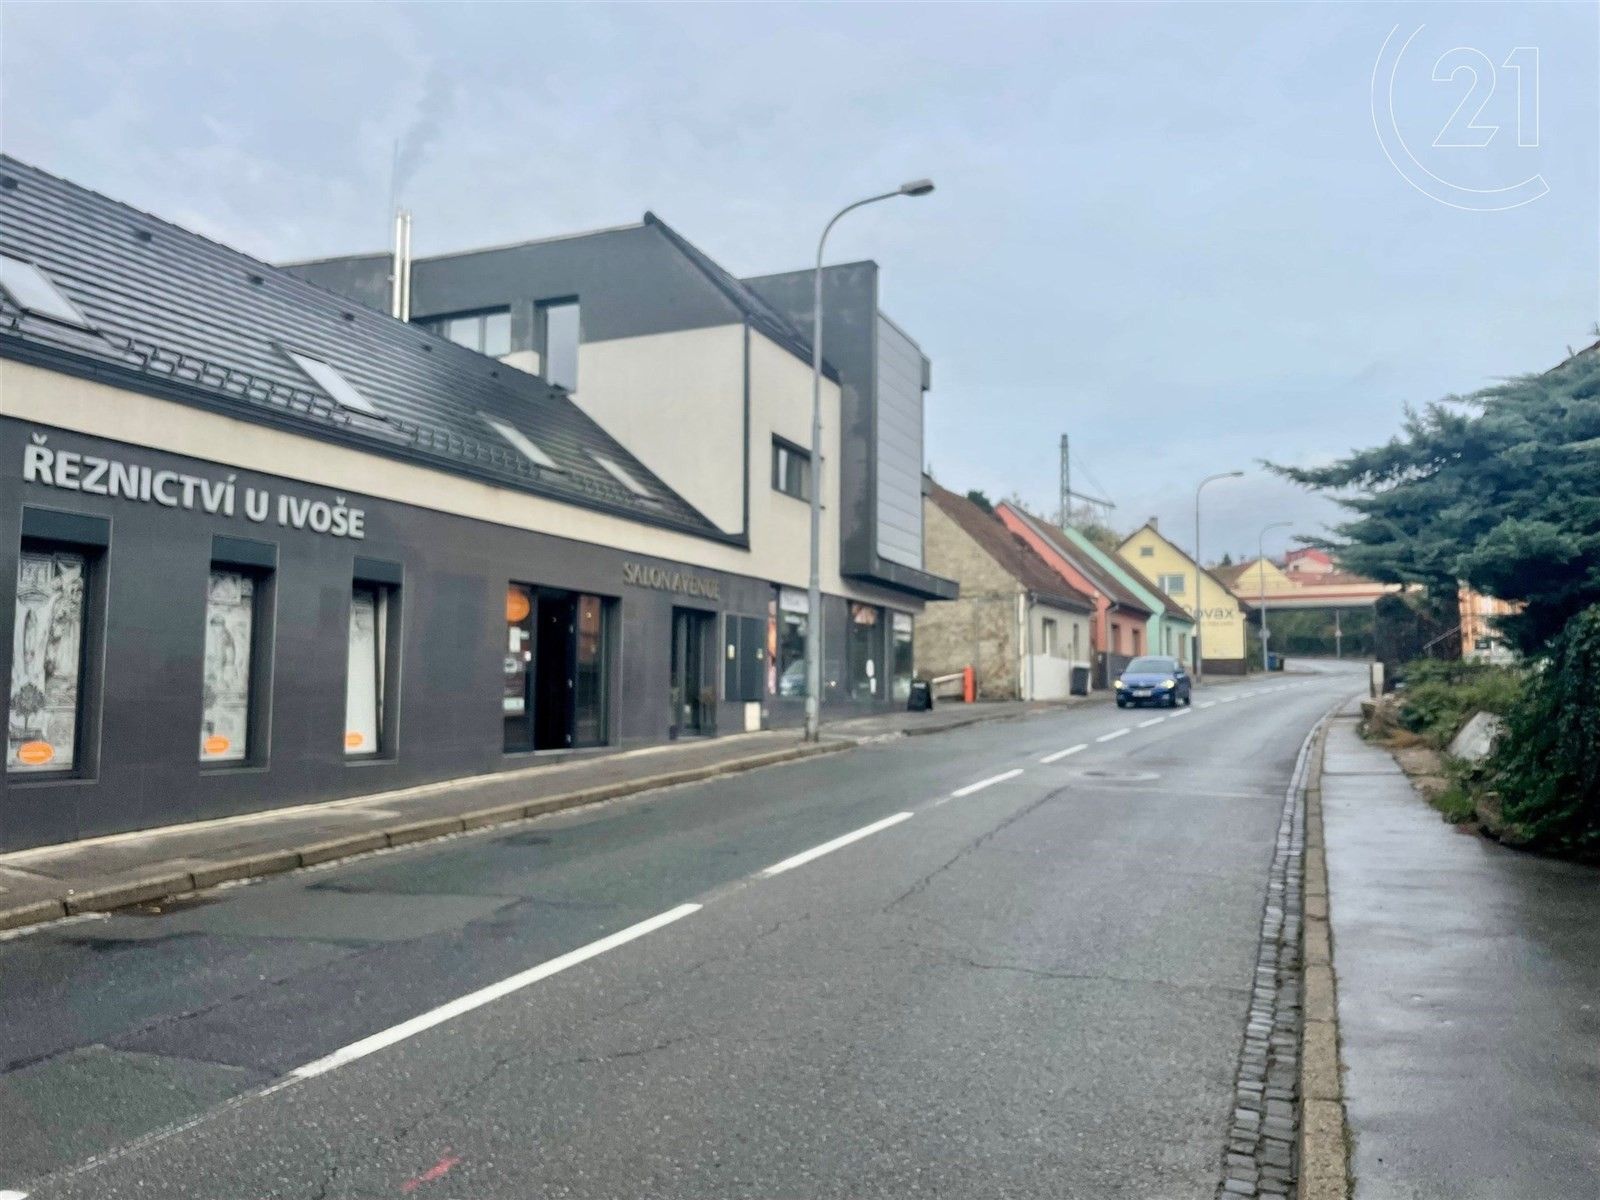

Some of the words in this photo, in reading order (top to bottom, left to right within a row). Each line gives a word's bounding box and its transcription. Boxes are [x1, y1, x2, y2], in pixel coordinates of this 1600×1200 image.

[23, 433, 235, 517] ŘEZNICTVÍ
[245, 487, 269, 522] U
[277, 494, 365, 539] IVOŠE
[622, 562, 671, 590] SALON
